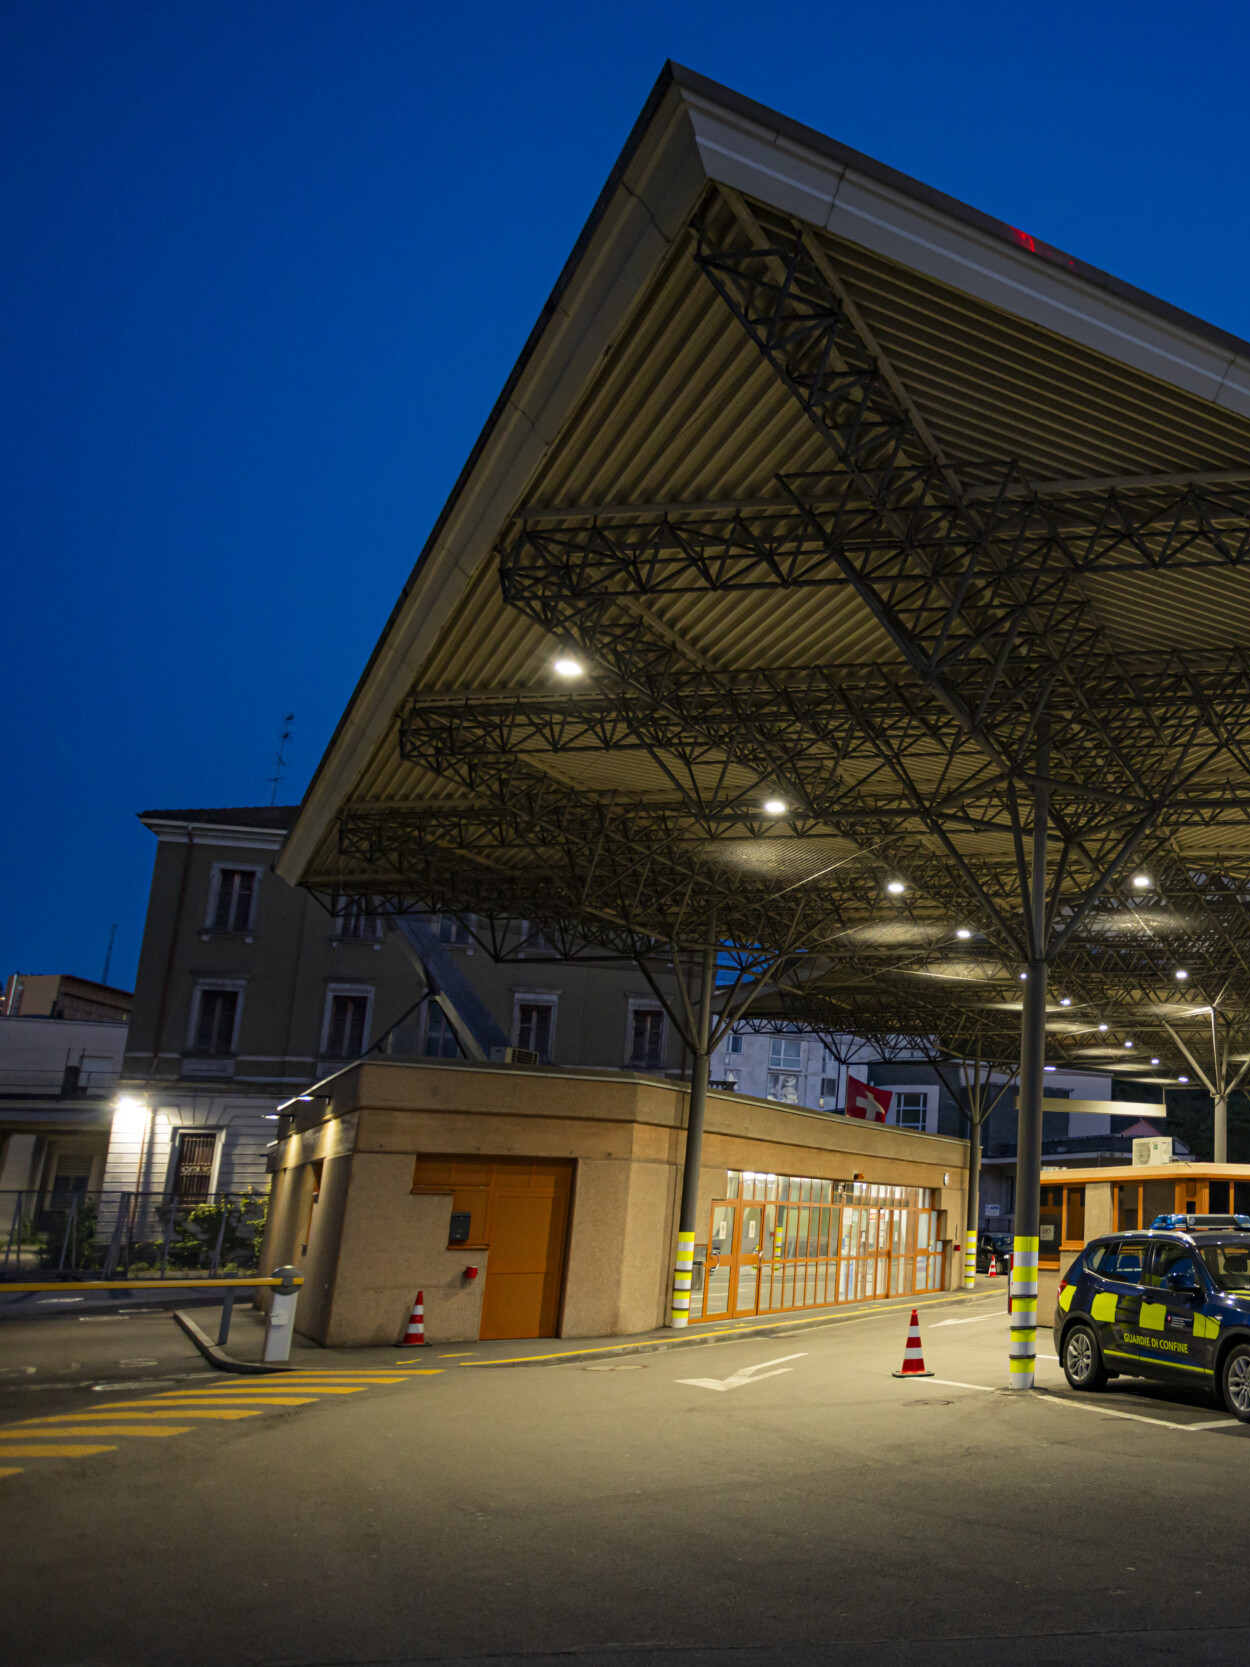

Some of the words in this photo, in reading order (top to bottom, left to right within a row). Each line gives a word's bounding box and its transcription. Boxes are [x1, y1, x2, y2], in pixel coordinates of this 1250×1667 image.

[1123, 1333, 1150, 1347] GUARDIE
[1151, 1338, 1159, 1349] DI
[1159, 1340, 1189, 1354] CONFINE
